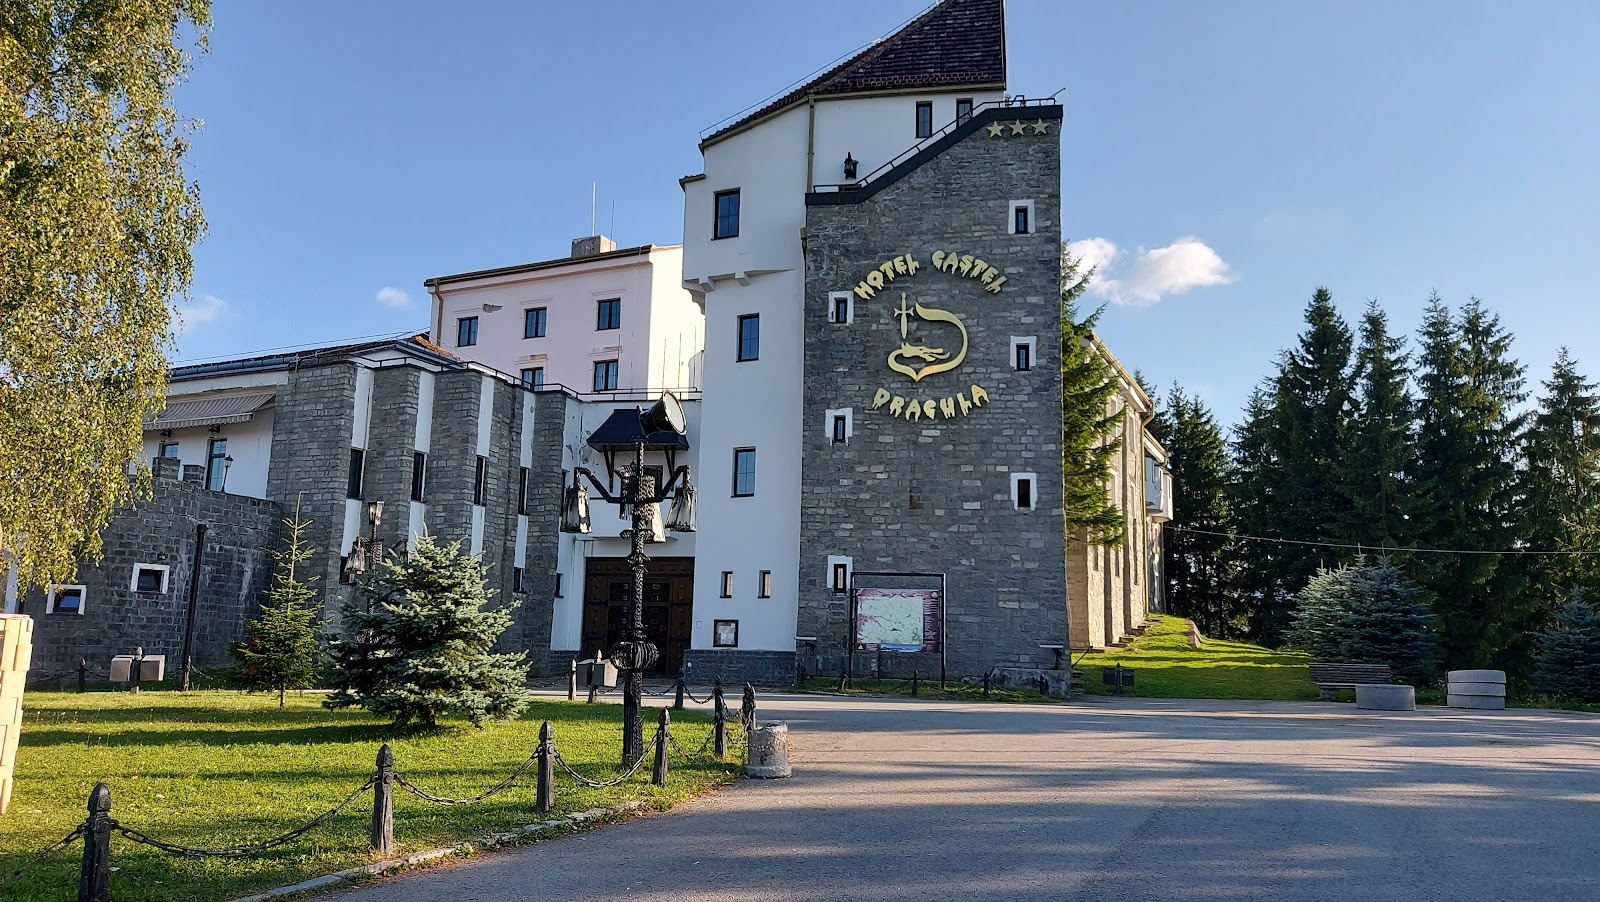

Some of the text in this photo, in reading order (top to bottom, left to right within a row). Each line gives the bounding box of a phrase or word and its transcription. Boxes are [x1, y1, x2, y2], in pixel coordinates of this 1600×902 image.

[853, 250, 1008, 299] HOTEL CASTEL
[872, 384, 989, 422] DRACULA
